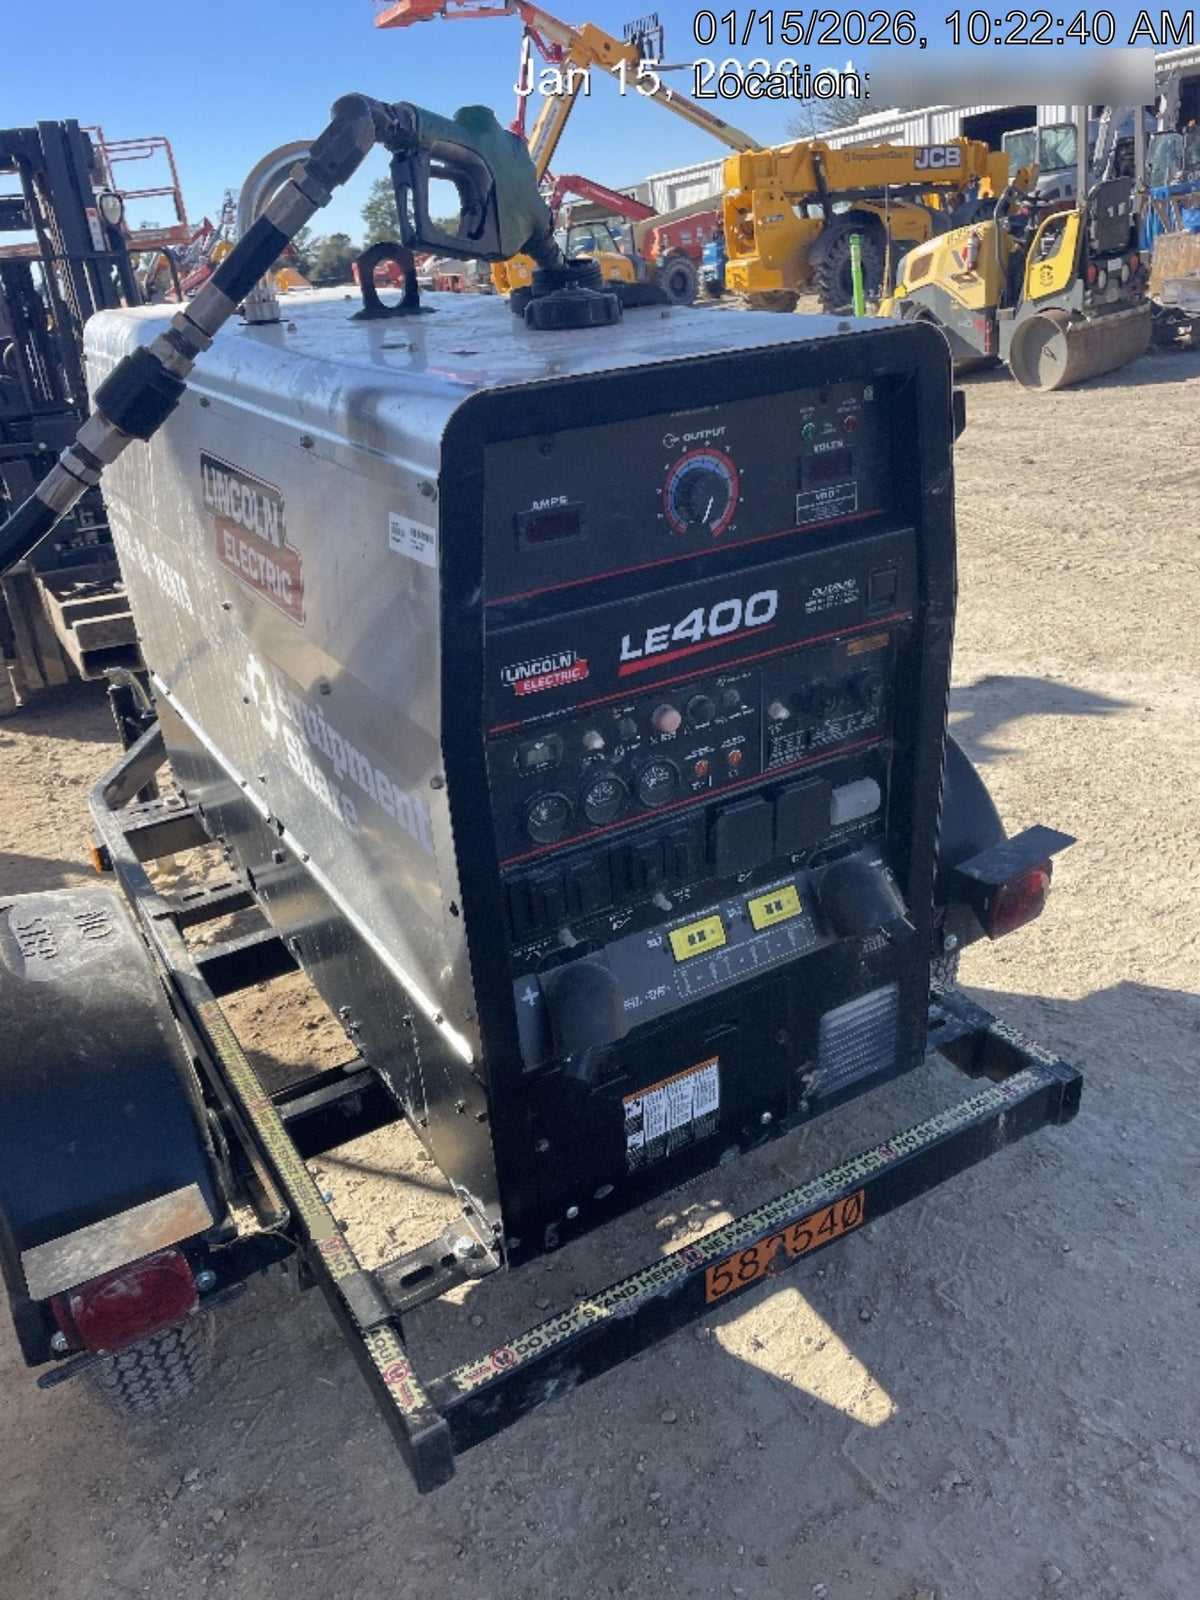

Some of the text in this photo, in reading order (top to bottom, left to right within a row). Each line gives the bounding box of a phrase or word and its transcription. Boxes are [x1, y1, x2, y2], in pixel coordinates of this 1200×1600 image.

[915, 147, 961, 168] JCB
[682, 426, 727, 442] OUTPUT
[203, 463, 280, 548] LINCOLN
[223, 529, 293, 605] ELECTRIC
[619, 589, 778, 662] LE400
[505, 653, 573, 681] LINCOLN
[523, 668, 581, 691] ELECTRIC
[701, 1237, 726, 1255] NE
[726, 1221, 756, 1242] PAS
[755, 1195, 803, 1224] TENEZ
[515, 1259, 685, 1356] DO NOT STAND HERE
